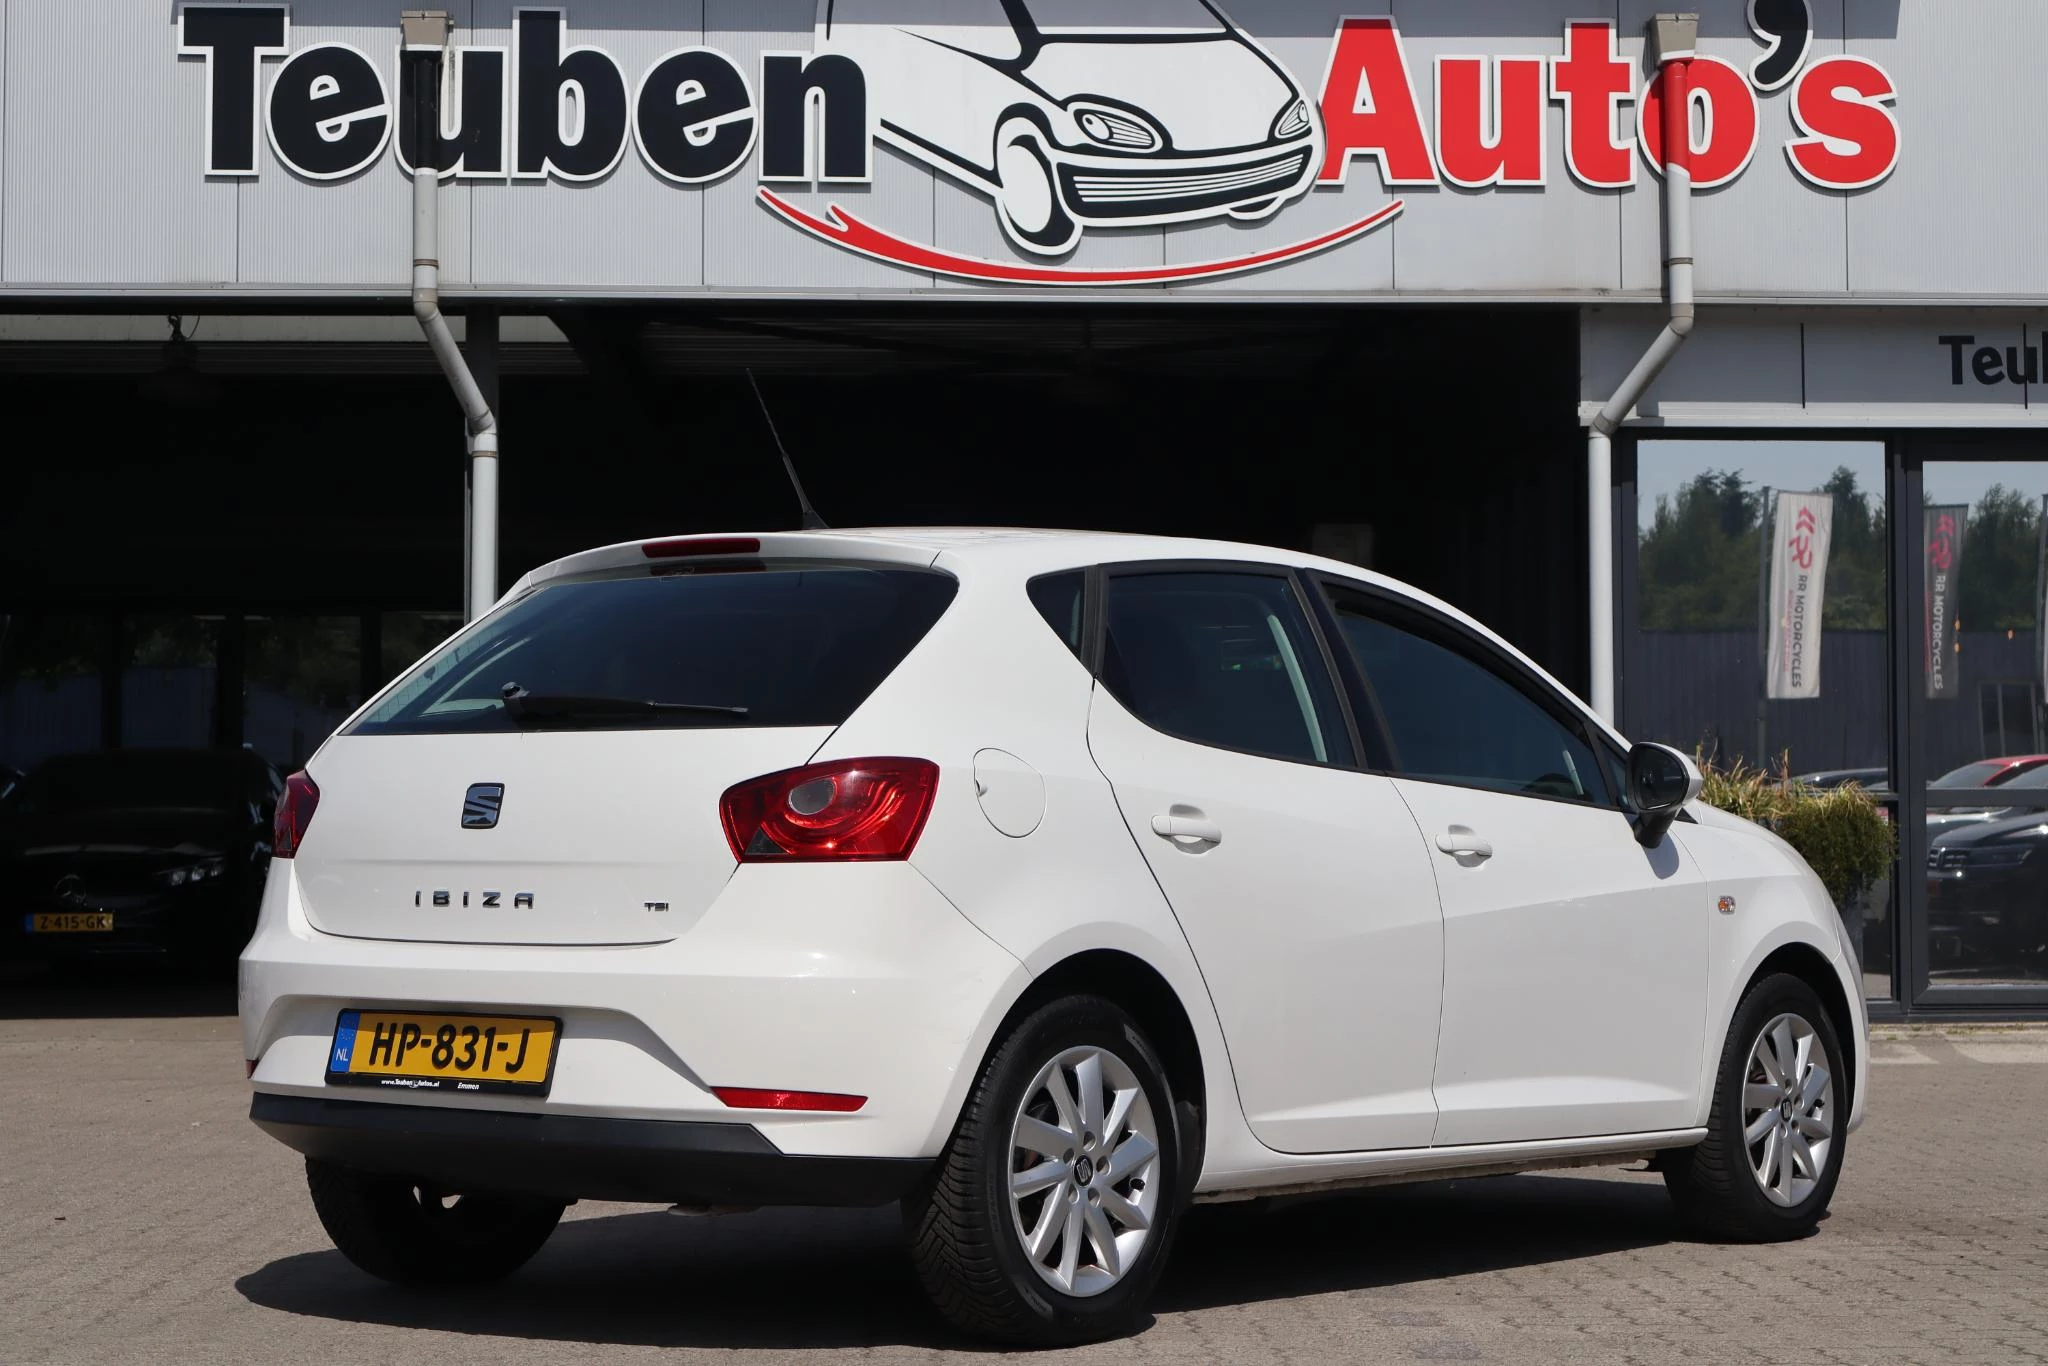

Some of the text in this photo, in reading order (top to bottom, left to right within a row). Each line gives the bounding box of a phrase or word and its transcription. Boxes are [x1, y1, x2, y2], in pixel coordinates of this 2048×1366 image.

[181, 0, 1900, 188] Teuben Auto's
[1938, 331, 2048, 385] Teu
[1792, 575, 1807, 688] RR MOTORCYCLES
[1932, 575, 1946, 689] RR MOTORCYCLES
[414, 890, 535, 909] IBIZA
[335, 1048, 349, 1062] NL
[368, 1021, 531, 1074] HP-831-J
[457, 1082, 480, 1090] Emmen
